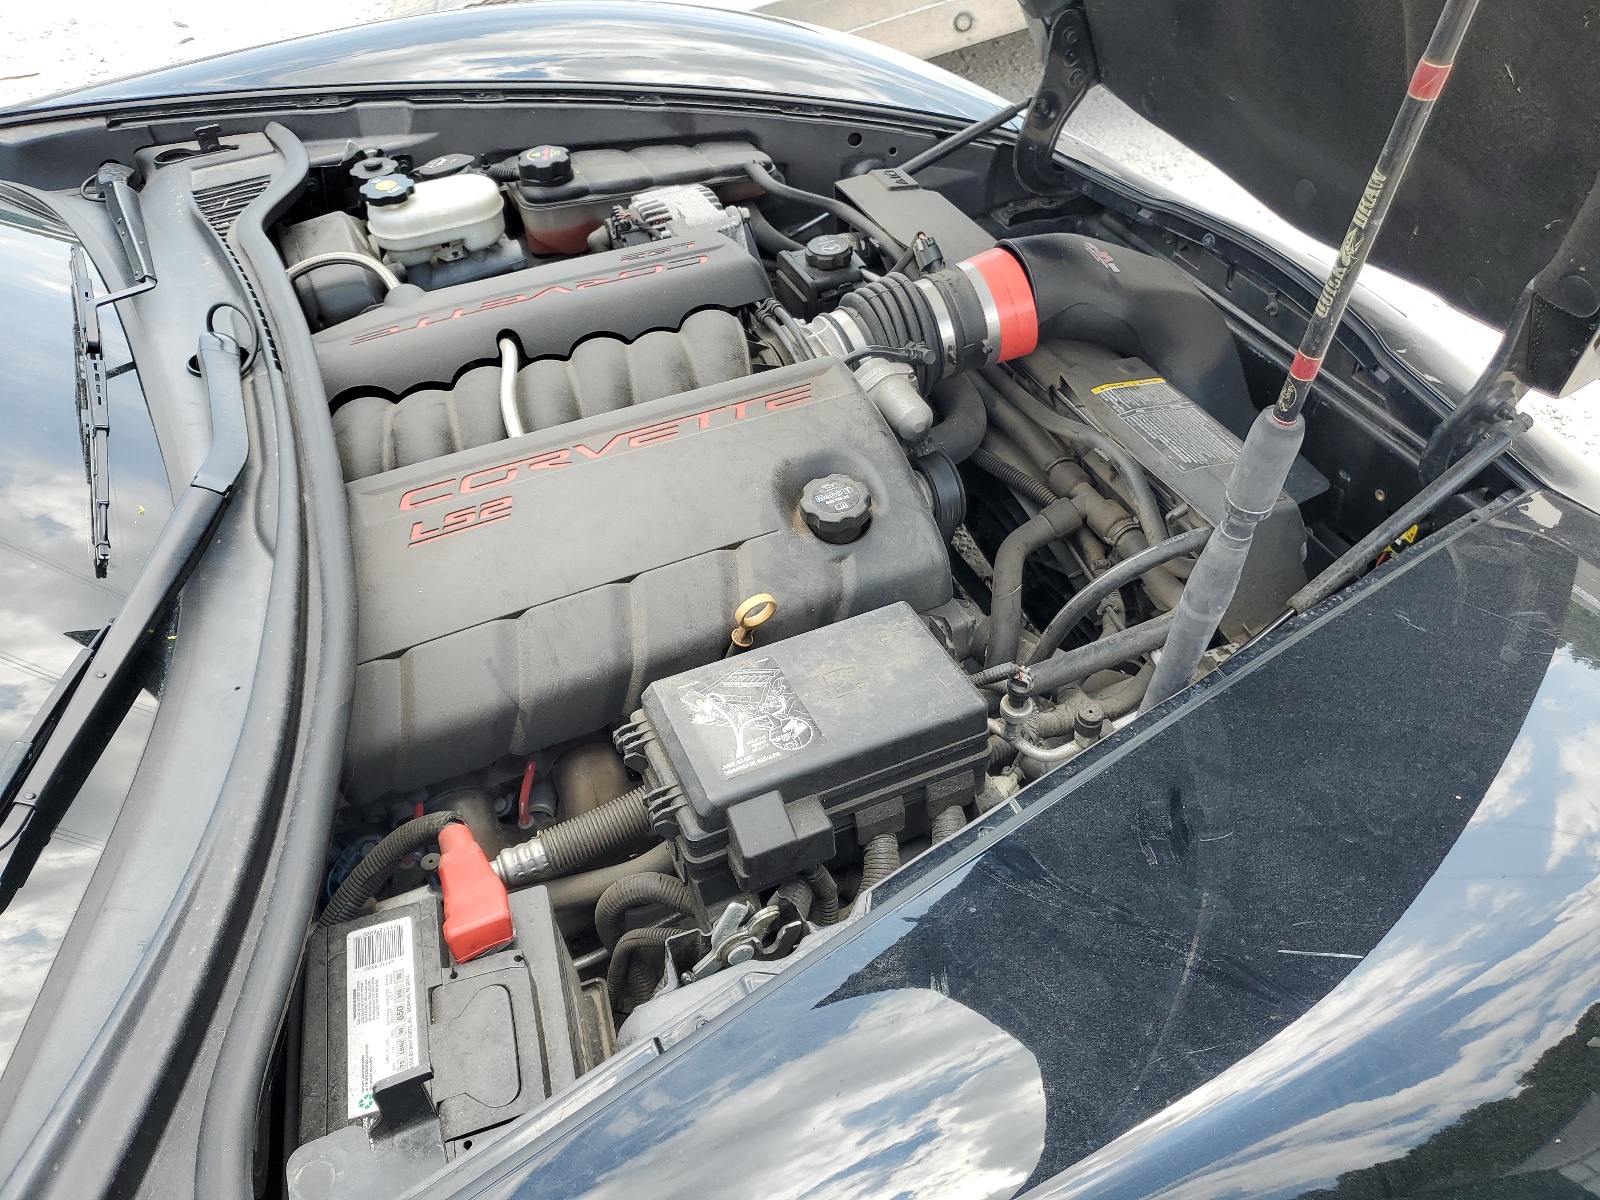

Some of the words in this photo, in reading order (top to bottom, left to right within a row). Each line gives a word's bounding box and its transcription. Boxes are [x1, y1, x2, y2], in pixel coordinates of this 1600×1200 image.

[399, 383, 812, 511] CORVETTE
[408, 496, 513, 540] LS2
[396, 1005, 404, 1021] 650
